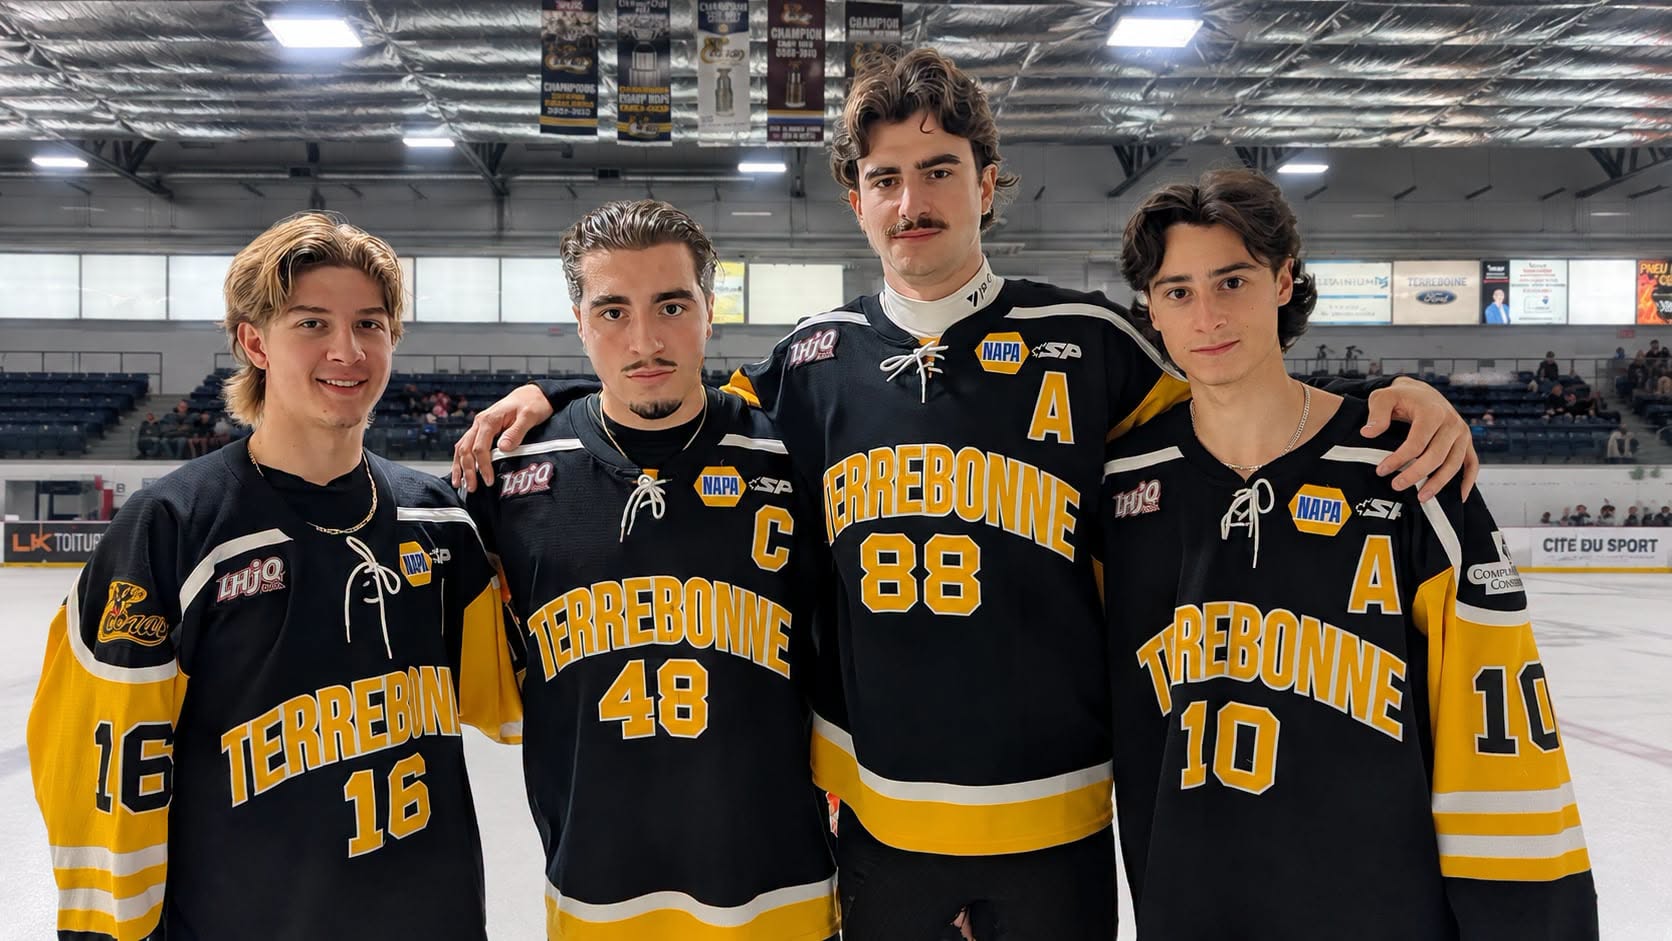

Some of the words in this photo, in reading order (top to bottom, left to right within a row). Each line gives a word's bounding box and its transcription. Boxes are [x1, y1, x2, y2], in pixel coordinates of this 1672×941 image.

[771, 27, 822, 40] CHAMPION
[982, 342, 1021, 363] NAPA
[1037, 341, 1082, 360] SP
[1027, 371, 1075, 445] A
[702, 475, 740, 496] NAPA
[754, 476, 793, 494] SP
[1295, 495, 1343, 524] NAPA
[12, 533, 52, 552] LK
[751, 504, 795, 572] C
[1581, 538, 1604, 552] DU
[1607, 538, 1659, 553] SPORT
[860, 532, 982, 617] 88
[1347, 535, 1403, 615] A
[527, 575, 793, 683] TERREBONNE
[598, 658, 709, 740] 48
[1472, 660, 1561, 758] 10
[93, 719, 174, 816] 16
[1181, 700, 1281, 796] 10
[343, 752, 432, 859] 16
